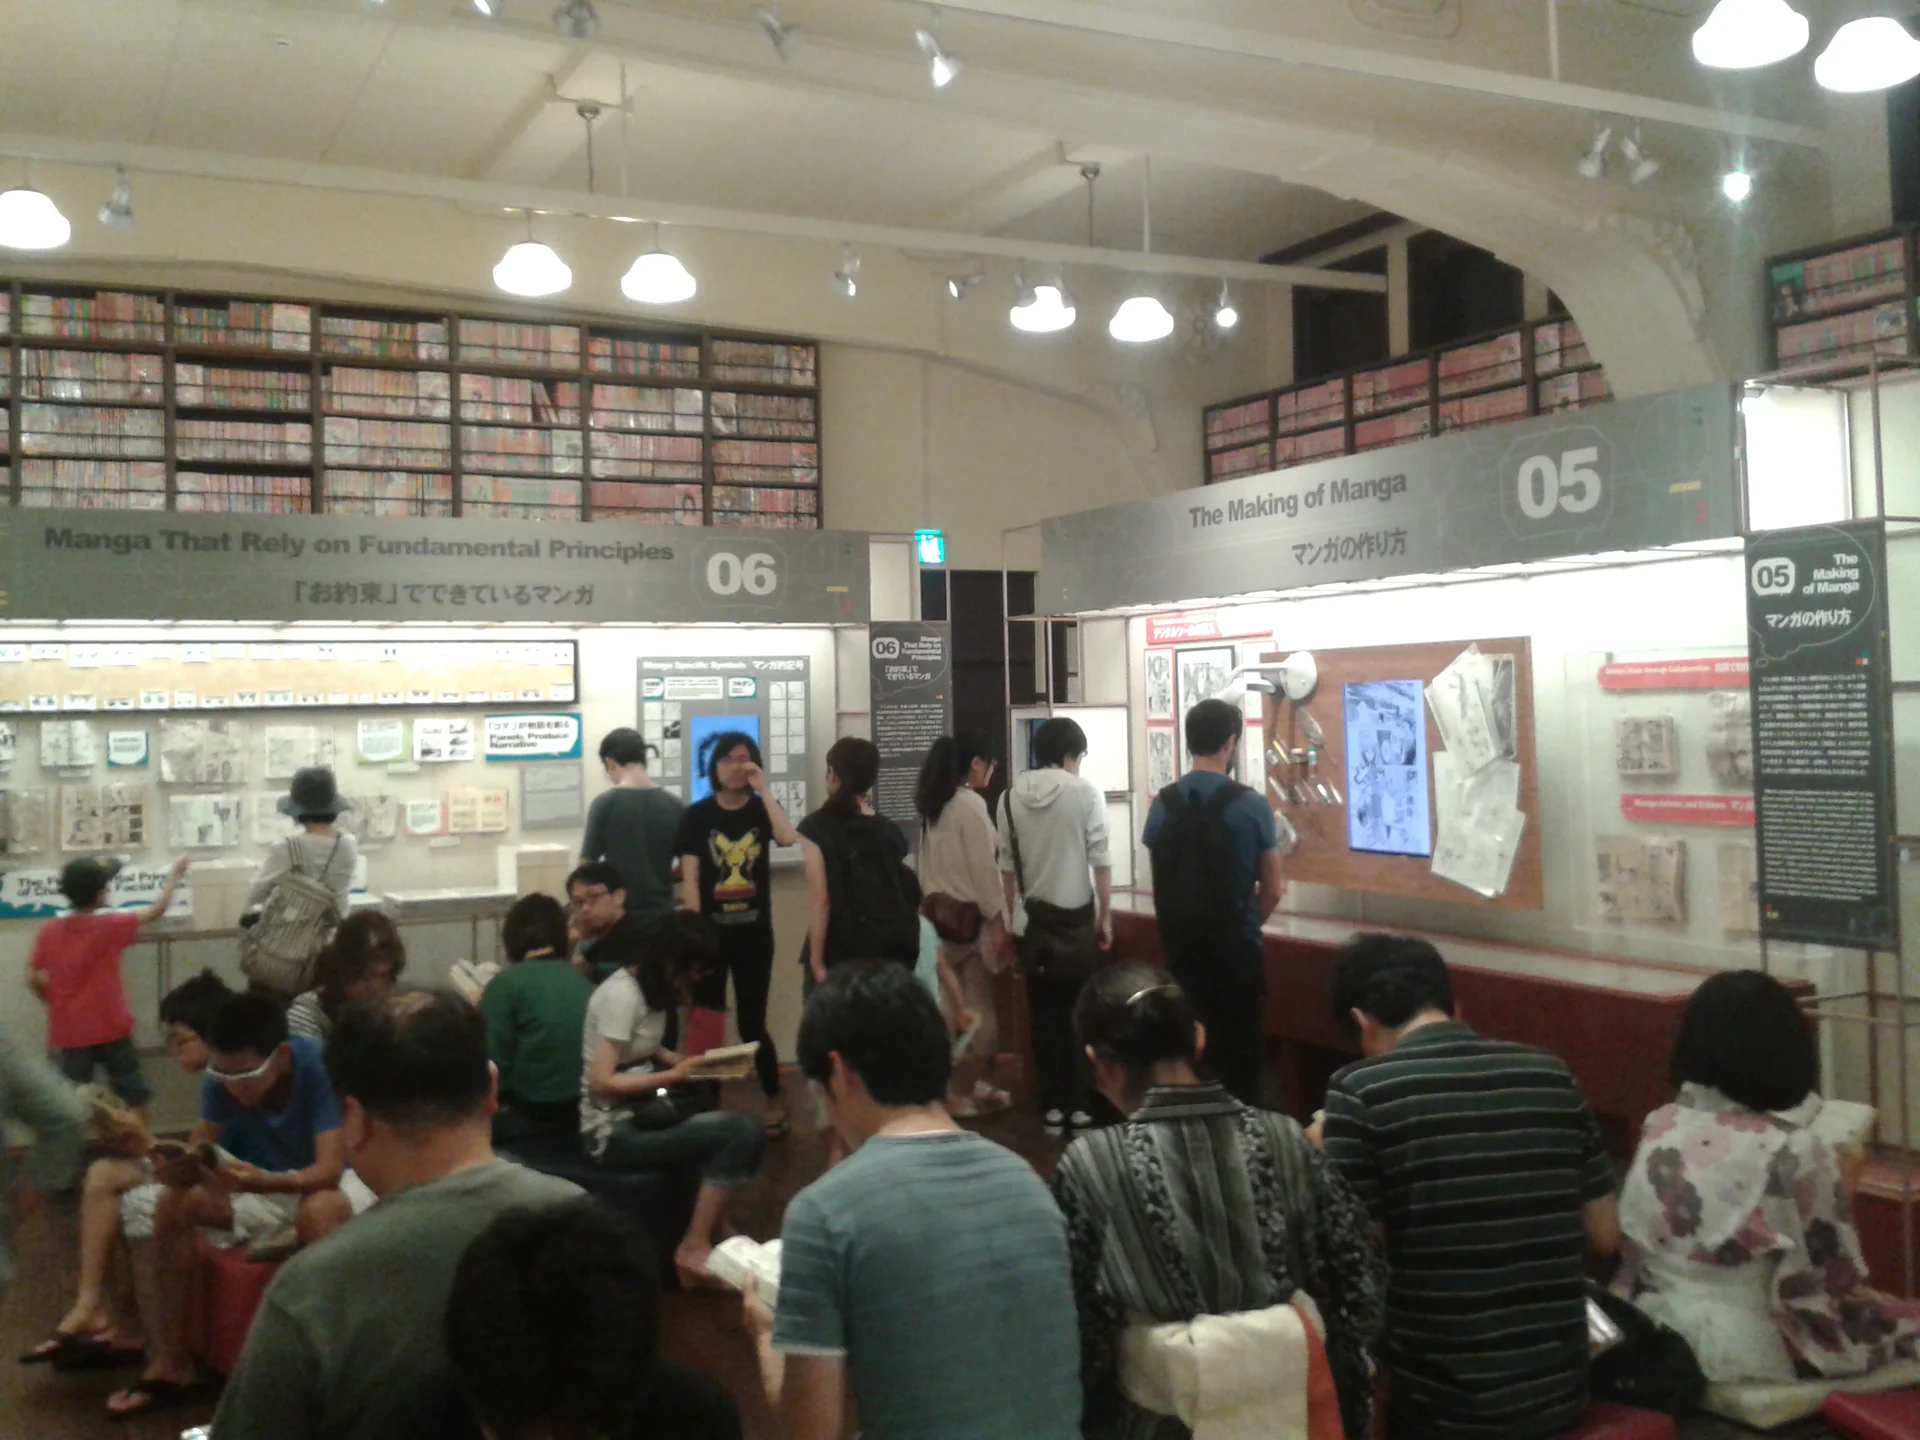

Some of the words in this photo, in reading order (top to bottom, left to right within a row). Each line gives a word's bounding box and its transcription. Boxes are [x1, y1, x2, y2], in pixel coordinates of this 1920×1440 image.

[1517, 446, 1601, 519] 05
[1189, 506, 1224, 528] The
[1228, 493, 1298, 522] Making
[1304, 482, 1326, 508] of
[1330, 473, 1407, 504] Manga
[44, 527, 152, 555] Manga
[160, 529, 231, 551] That
[242, 532, 305, 558] Rely
[314, 539, 350, 554] on
[359, 535, 540, 558] Fundamental
[549, 540, 674, 565] Principles
[1291, 527, 1408, 566] マンガの作り方
[1833, 553, 1858, 565] The
[707, 552, 777, 595] 06
[1757, 565, 1790, 588] 05
[1813, 567, 1859, 580] Making
[295, 580, 594, 606] 「お約束」でできているマンガ
[1802, 582, 1814, 595] of
[1817, 582, 1860, 594] Manga
[1765, 608, 1852, 628] マンガの作り方
[876, 641, 897, 655] 06
